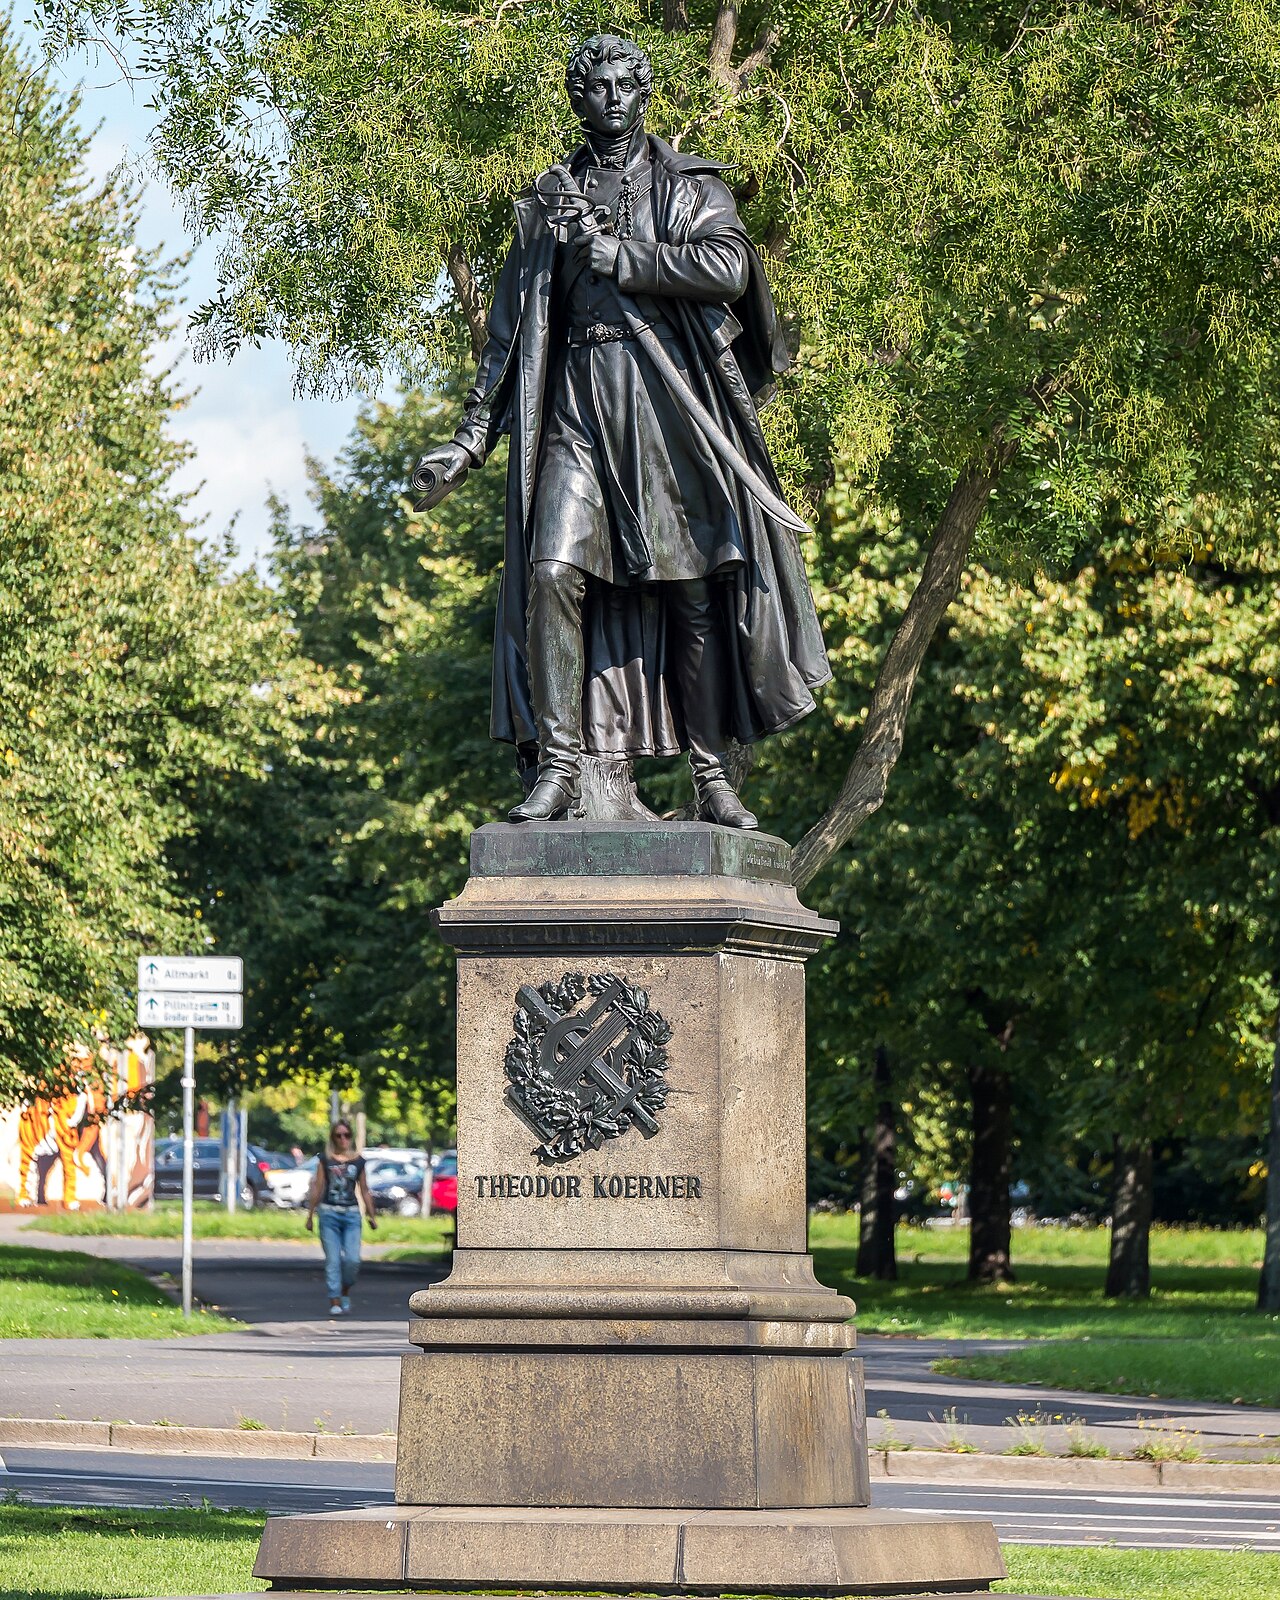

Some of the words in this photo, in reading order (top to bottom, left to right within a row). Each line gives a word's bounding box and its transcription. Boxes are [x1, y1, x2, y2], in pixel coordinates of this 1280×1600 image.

[164, 969, 209, 980] Altmarkt
[163, 1000, 198, 1011] Pillnitz
[474, 1175, 582, 1199] THEODOR
[592, 1175, 702, 1199] KOERNER
